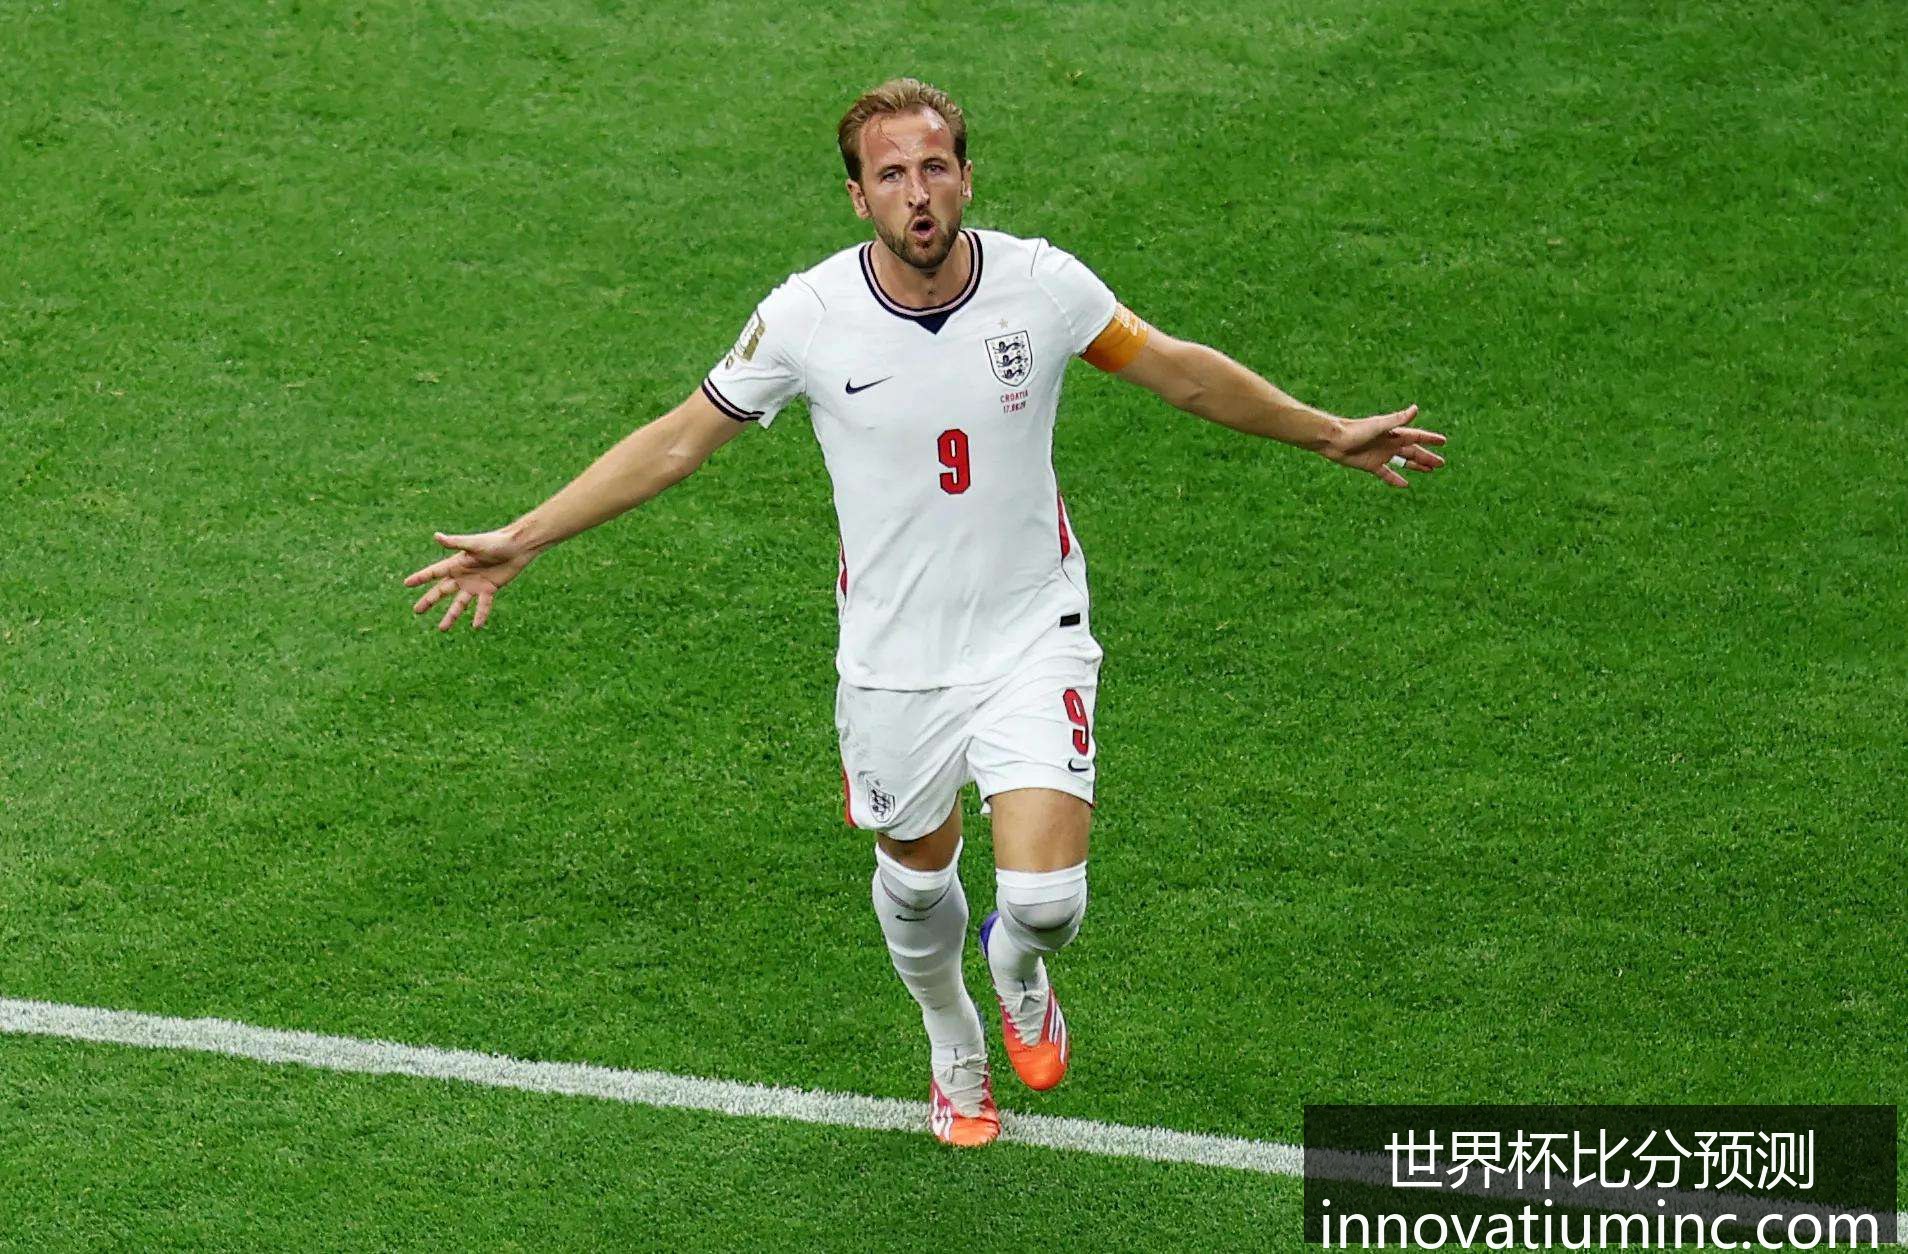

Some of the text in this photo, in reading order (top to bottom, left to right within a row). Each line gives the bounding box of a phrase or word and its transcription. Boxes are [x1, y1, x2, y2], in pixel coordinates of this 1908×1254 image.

[1000, 389, 1028, 403] CROATIA
[937, 428, 971, 495] 9
[1062, 688, 1090, 756] 9
